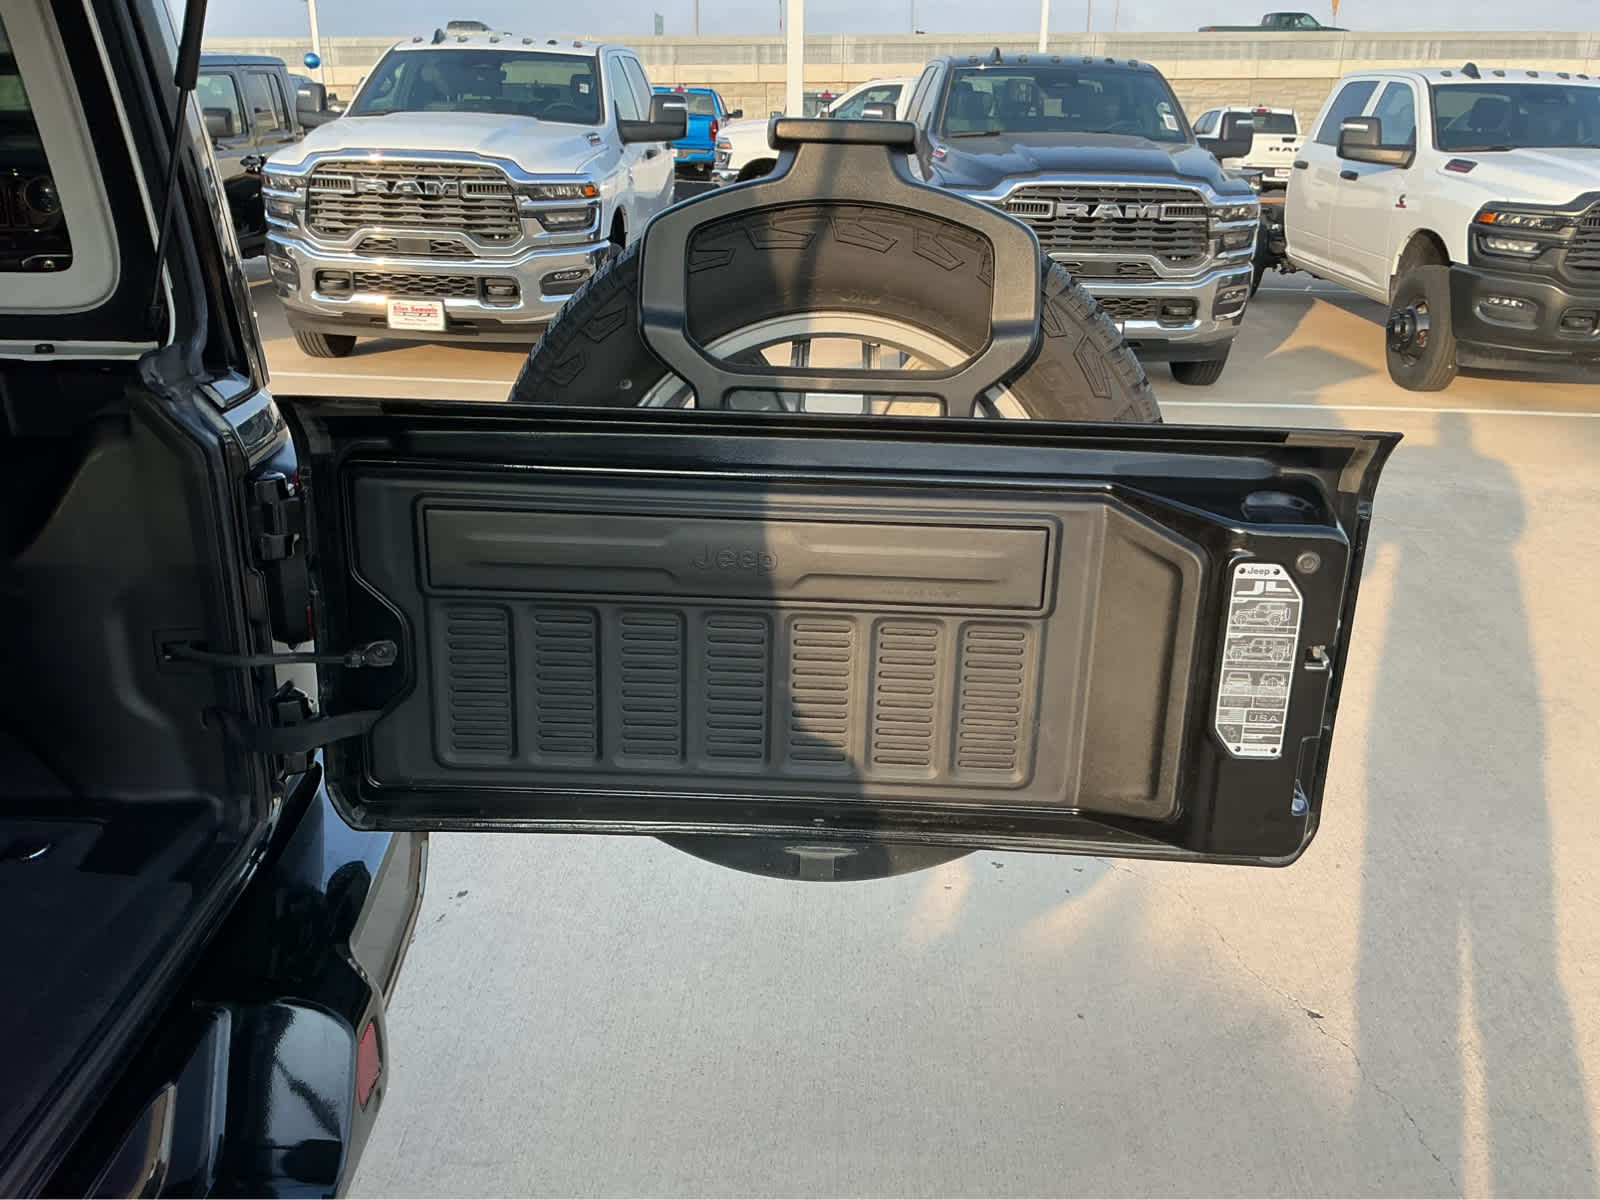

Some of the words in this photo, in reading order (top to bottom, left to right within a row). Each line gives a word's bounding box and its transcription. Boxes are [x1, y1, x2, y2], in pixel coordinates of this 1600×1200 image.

[356, 180, 459, 196] RAM
[1056, 202, 1161, 218] RAM
[692, 544, 779, 576] Jeep
[1247, 567, 1271, 576] Jeep
[1249, 713, 1279, 723] USA
